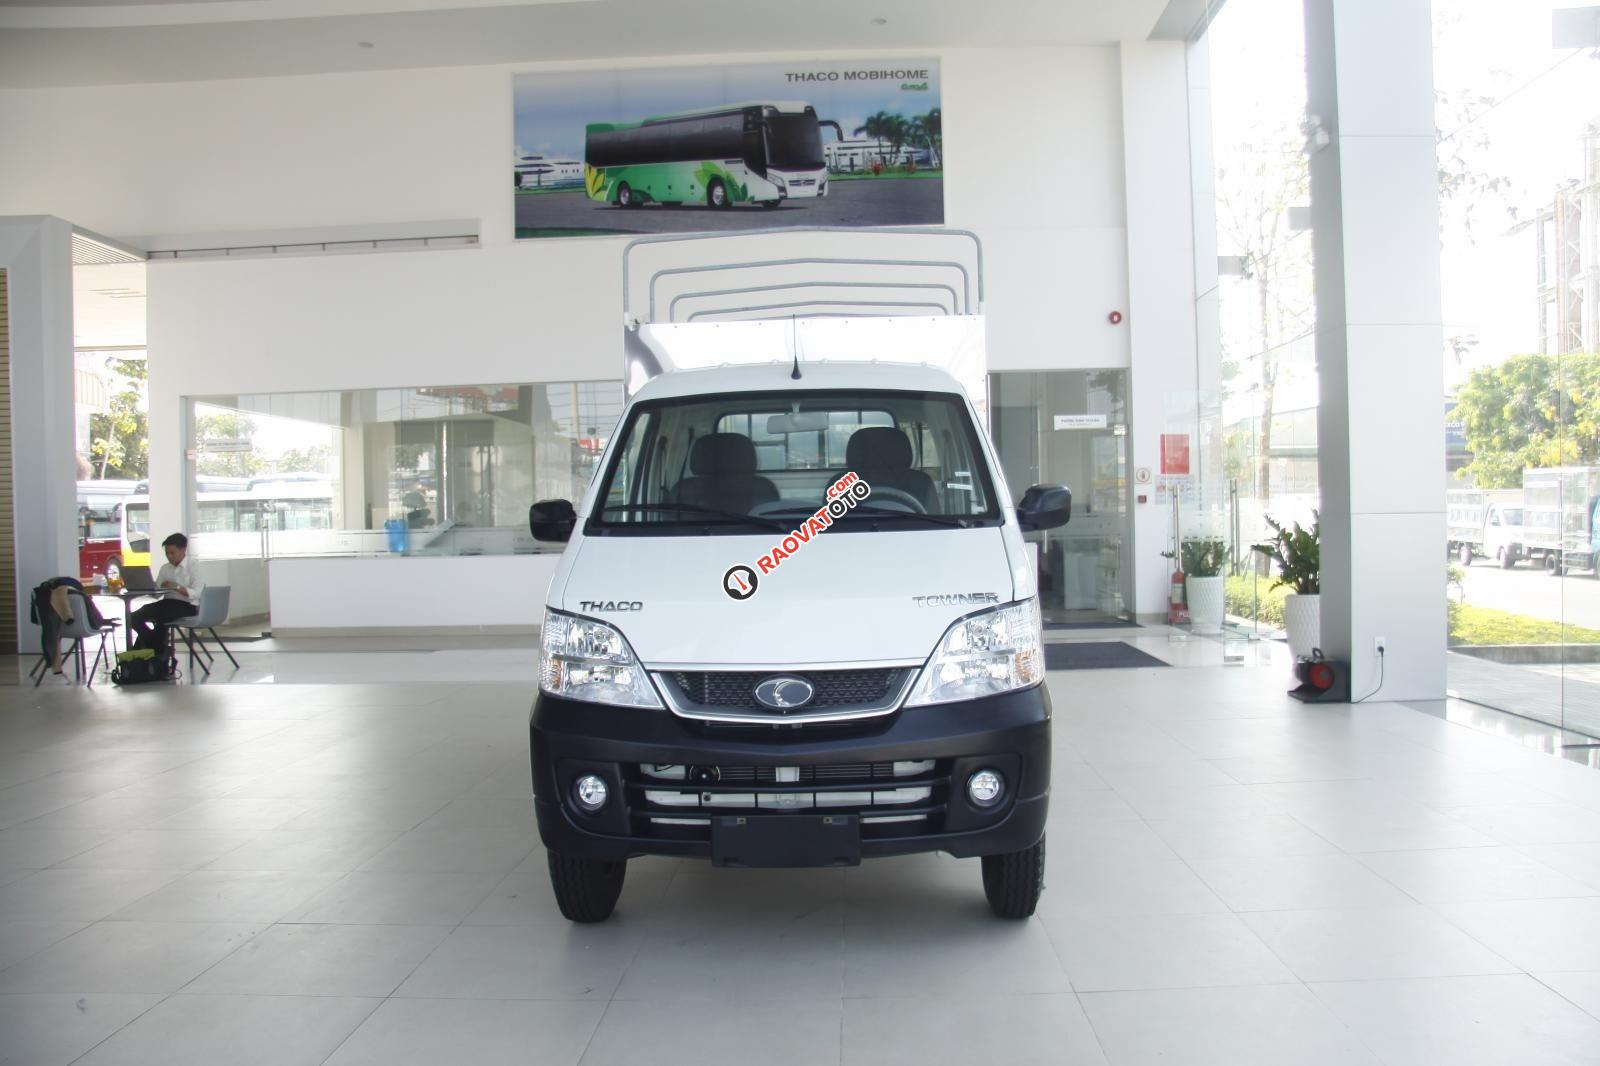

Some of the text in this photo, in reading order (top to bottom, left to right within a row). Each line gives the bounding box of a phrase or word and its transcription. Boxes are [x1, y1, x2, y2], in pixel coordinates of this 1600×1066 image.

[784, 69, 929, 82] THACO MOBIHOME
[579, 601, 643, 612] THACO
[912, 592, 1000, 608] TOWNER
